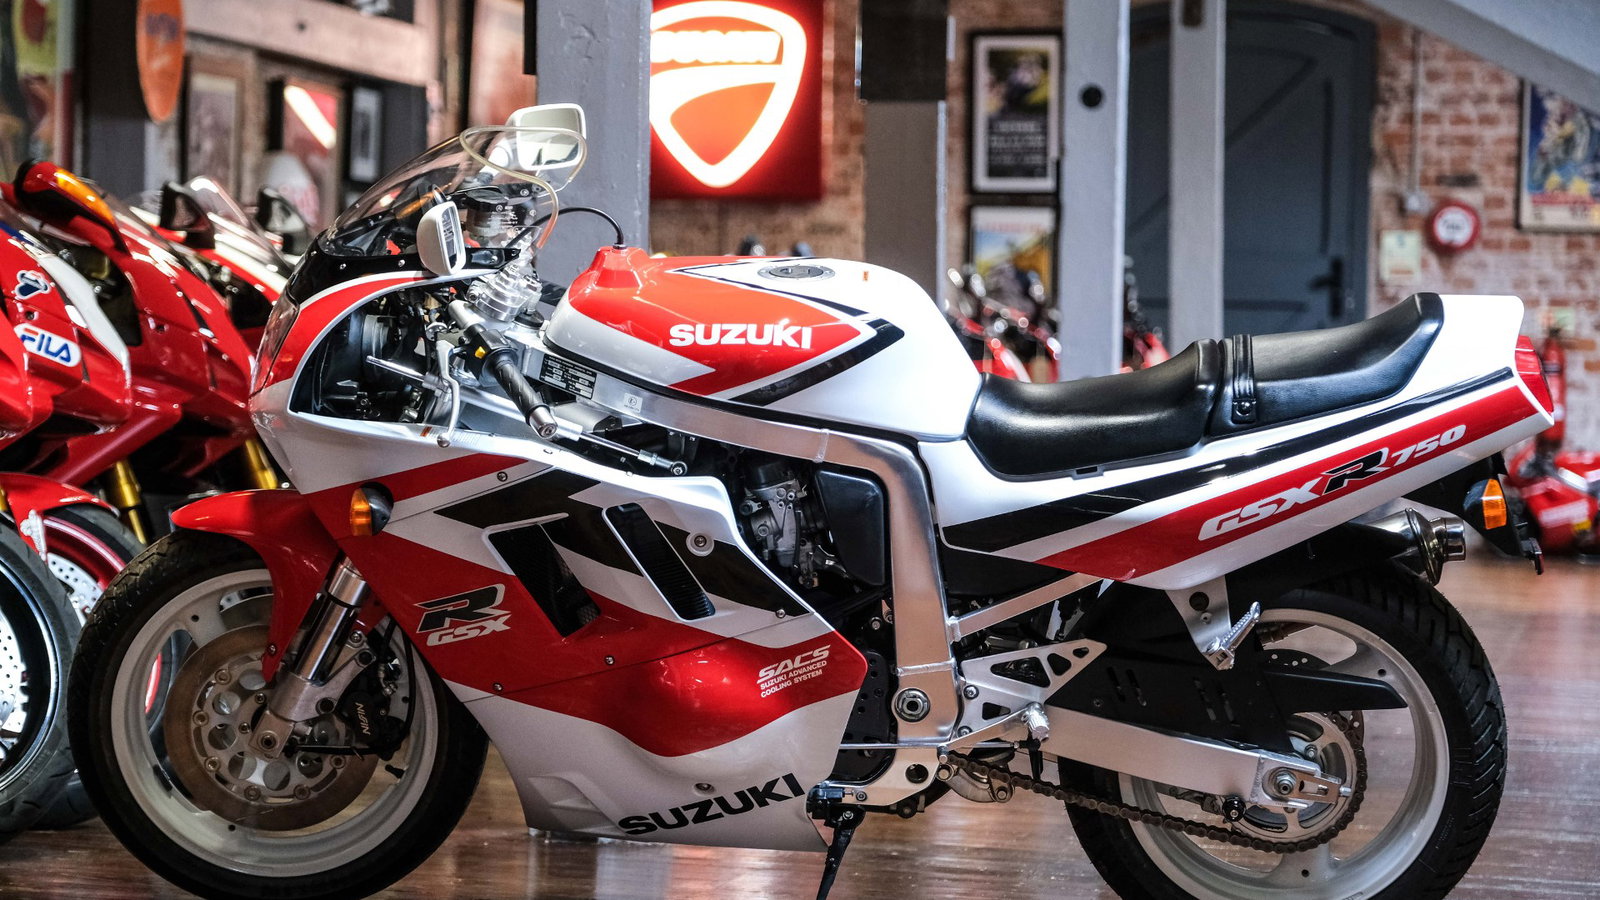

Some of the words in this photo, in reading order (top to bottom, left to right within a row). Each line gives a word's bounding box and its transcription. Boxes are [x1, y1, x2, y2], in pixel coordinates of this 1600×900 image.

[669, 322, 813, 350] SUZUKI
[426, 614, 512, 646] GSX
[756, 644, 831, 684] SACS
[760, 675, 787, 690] SUZUKI
[788, 660, 827, 679] ADVANCED
[760, 679, 793, 698] COOLING
[793, 668, 823, 684] SYSTEM
[617, 773, 806, 835] SUZUKI
